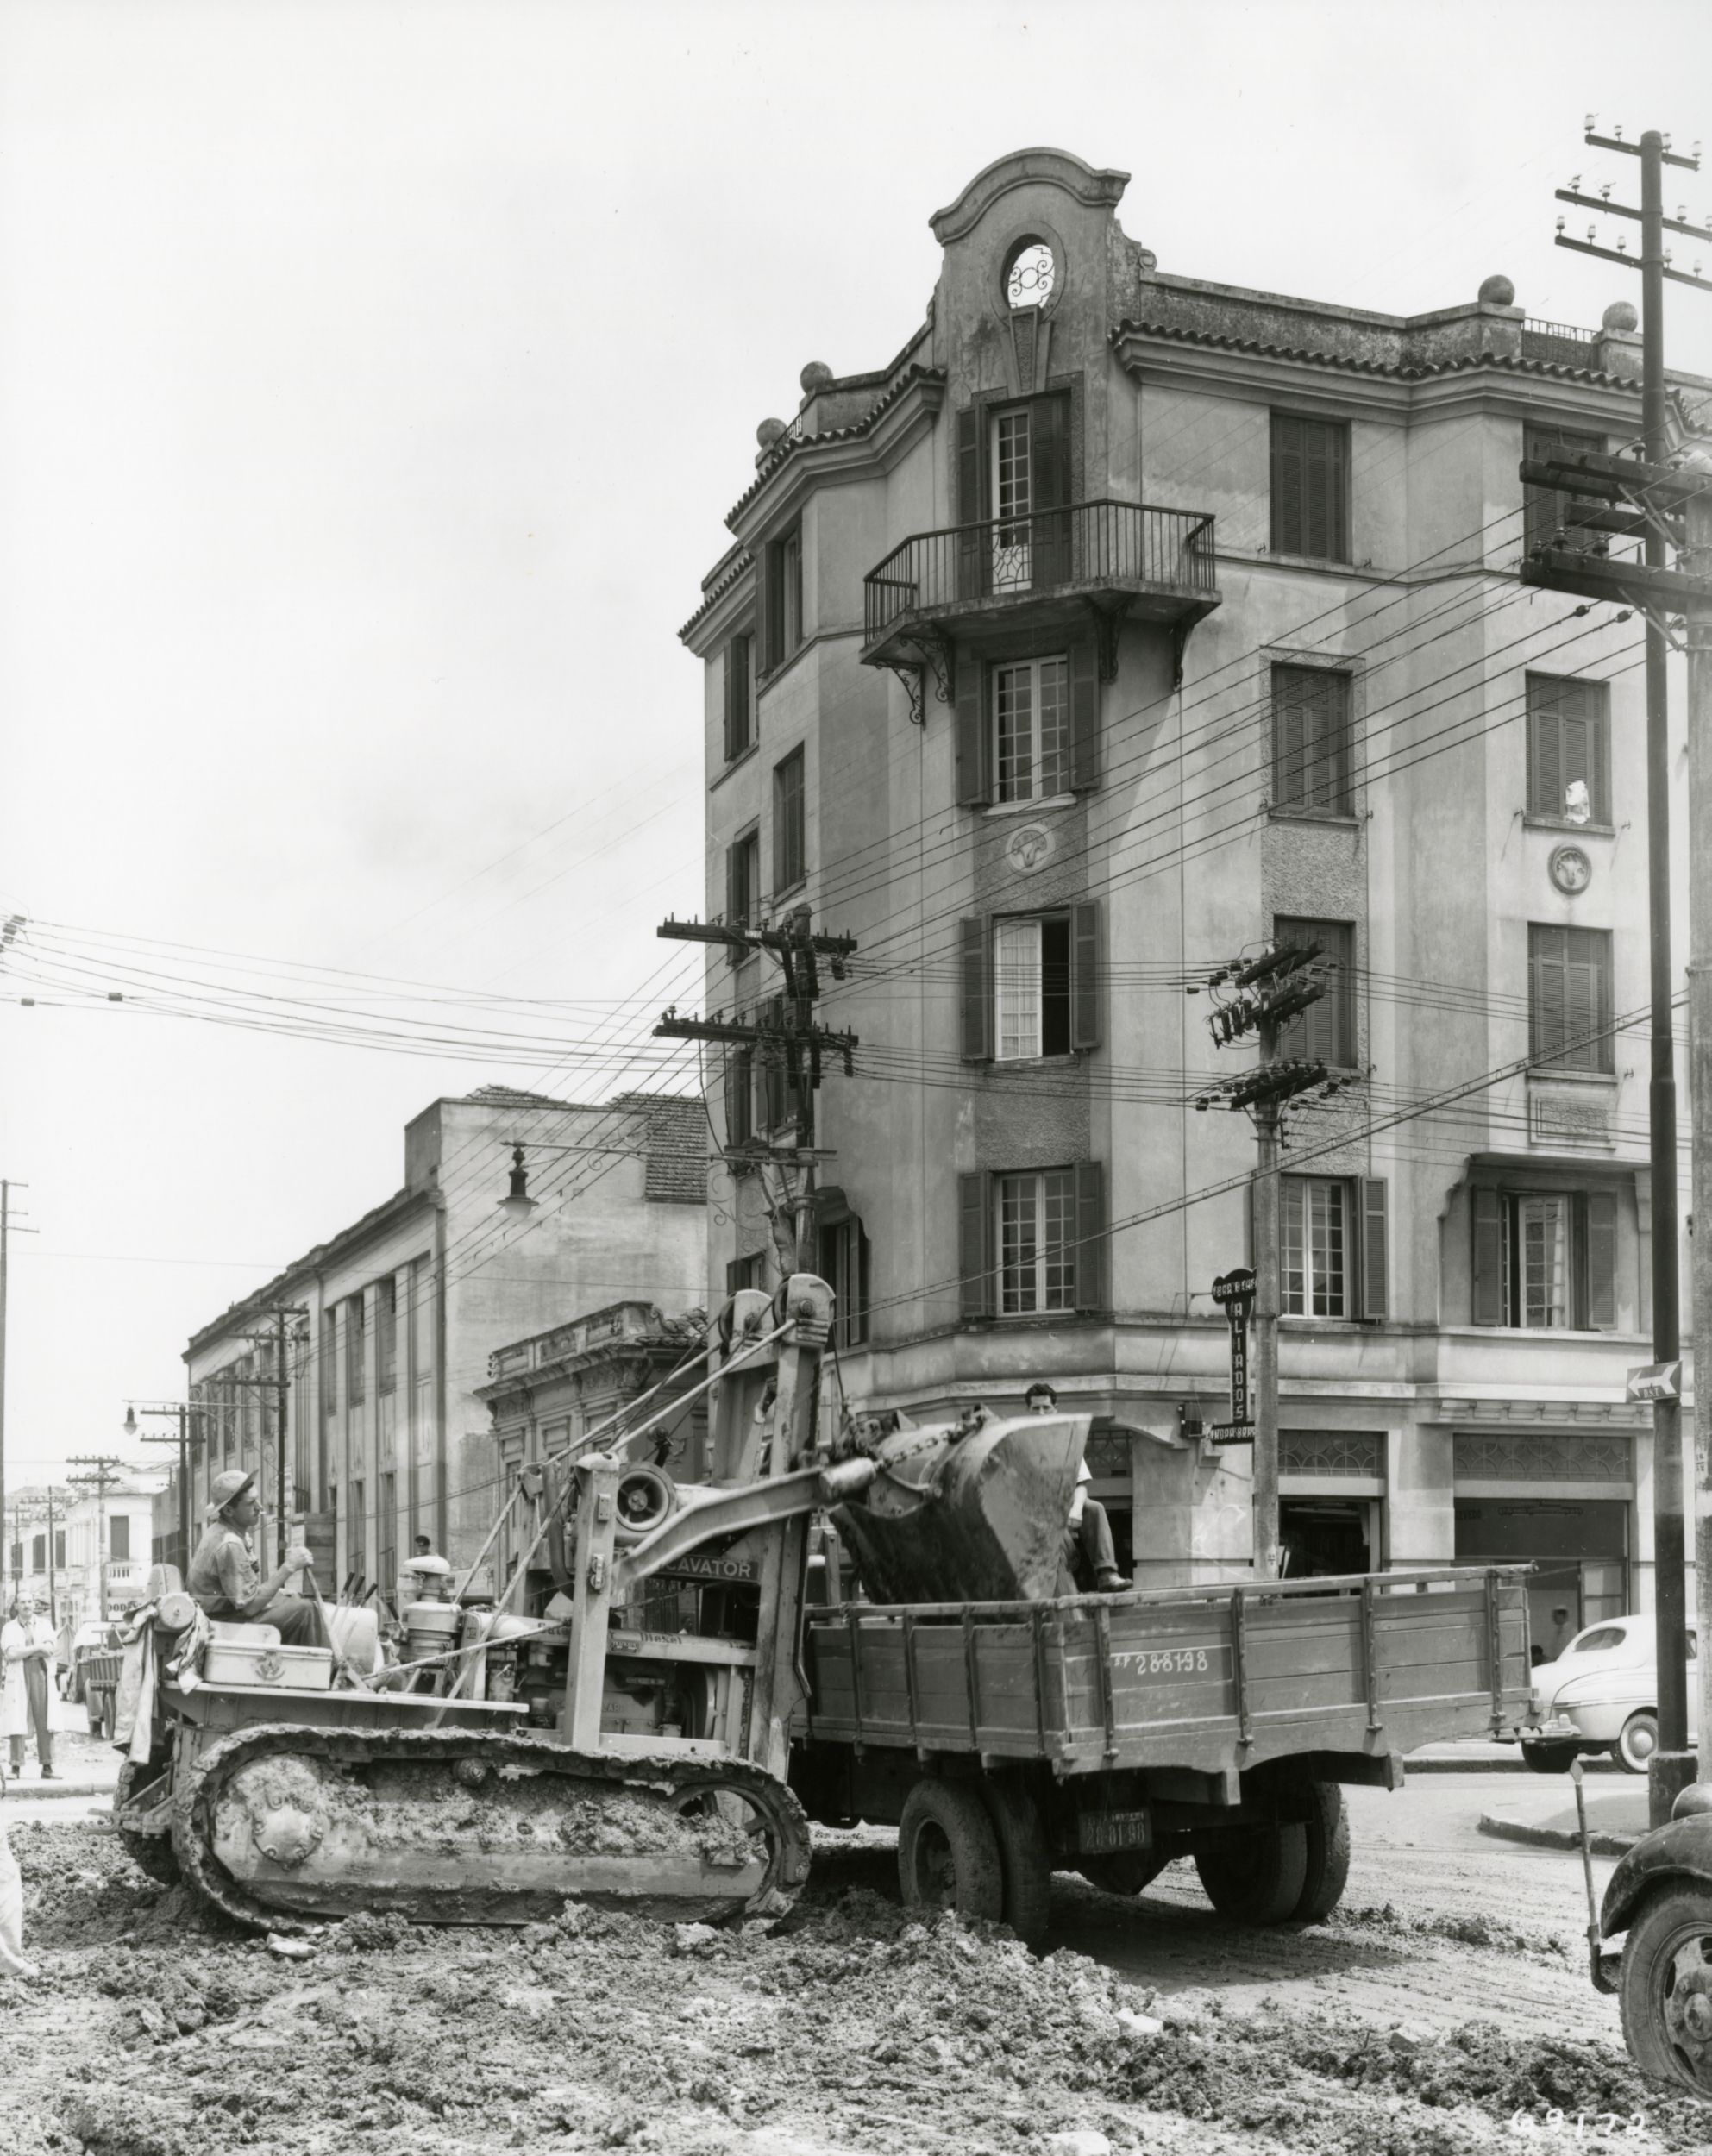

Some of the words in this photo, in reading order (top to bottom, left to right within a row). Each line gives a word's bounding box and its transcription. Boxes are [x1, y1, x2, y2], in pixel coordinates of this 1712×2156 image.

[1234, 1302, 1245, 1420] ALIADOS
[662, 1557, 751, 1578] CAVATOR
[739, 1680, 750, 1758] CATERPILLA
